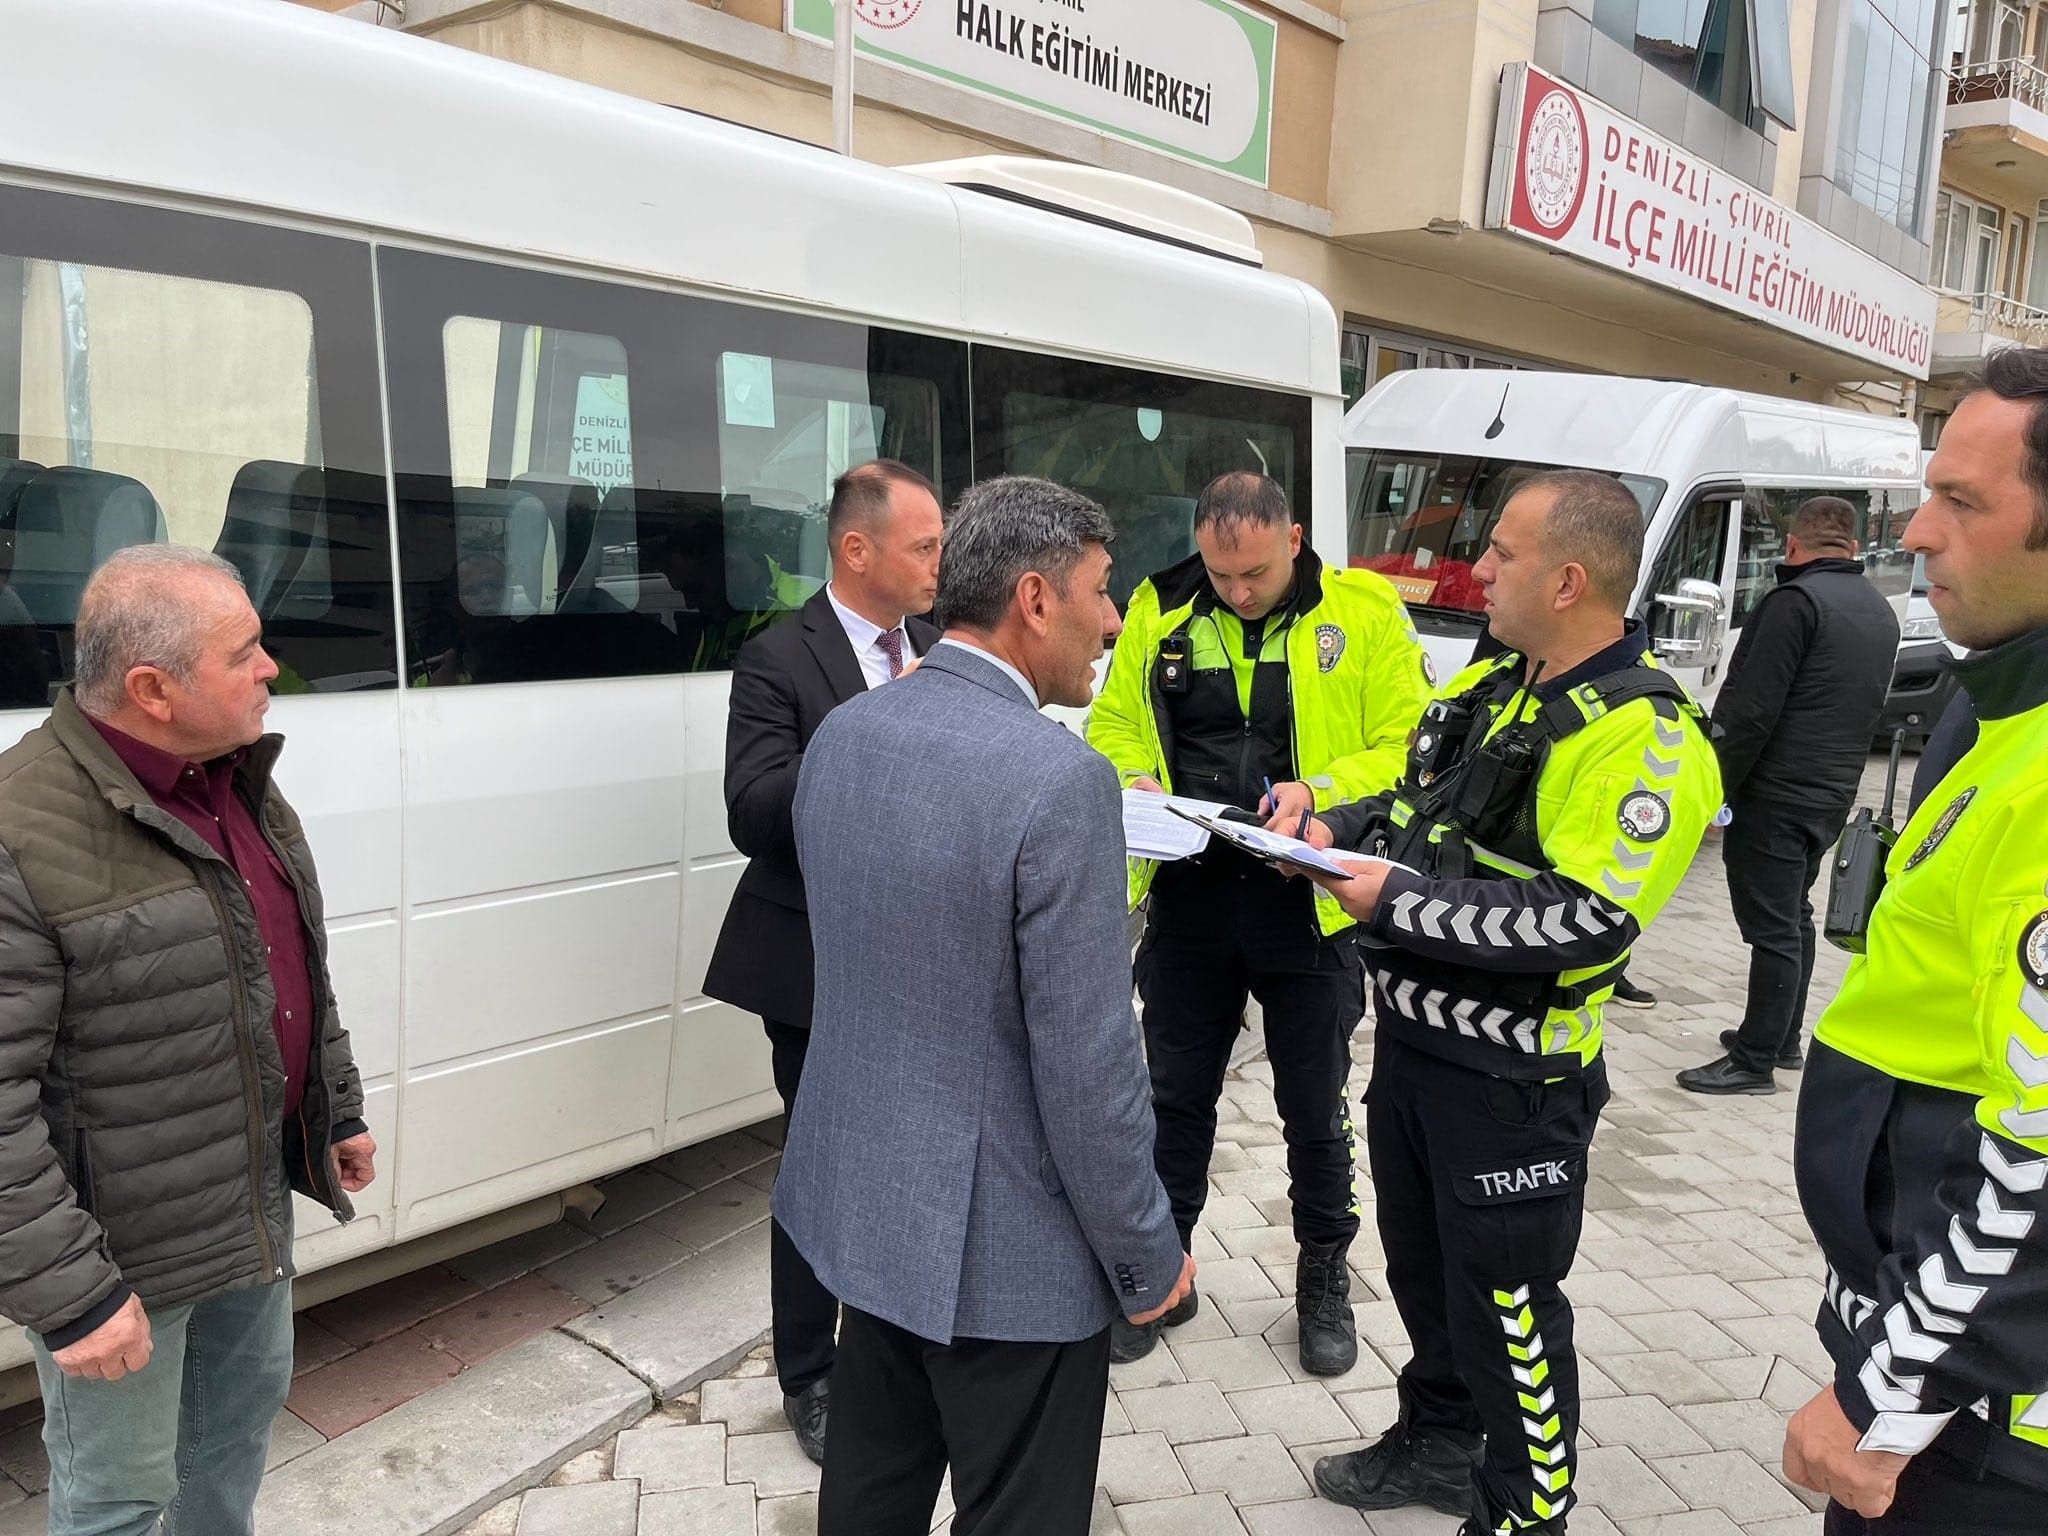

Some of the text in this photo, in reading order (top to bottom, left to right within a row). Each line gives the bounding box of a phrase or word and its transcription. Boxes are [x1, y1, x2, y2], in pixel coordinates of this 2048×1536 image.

[956, 0, 1211, 126] HALK EĞİTİMİ MERKEZİ
[1603, 125, 1711, 207] DENİZLİ
[1729, 192, 1791, 249] ÇİVRİL
[1592, 171, 1929, 367] İLÇE MİLLİ EĞİTİM MÜDÜRLÜĞÜ
[579, 415, 627, 429] DENİZLİ
